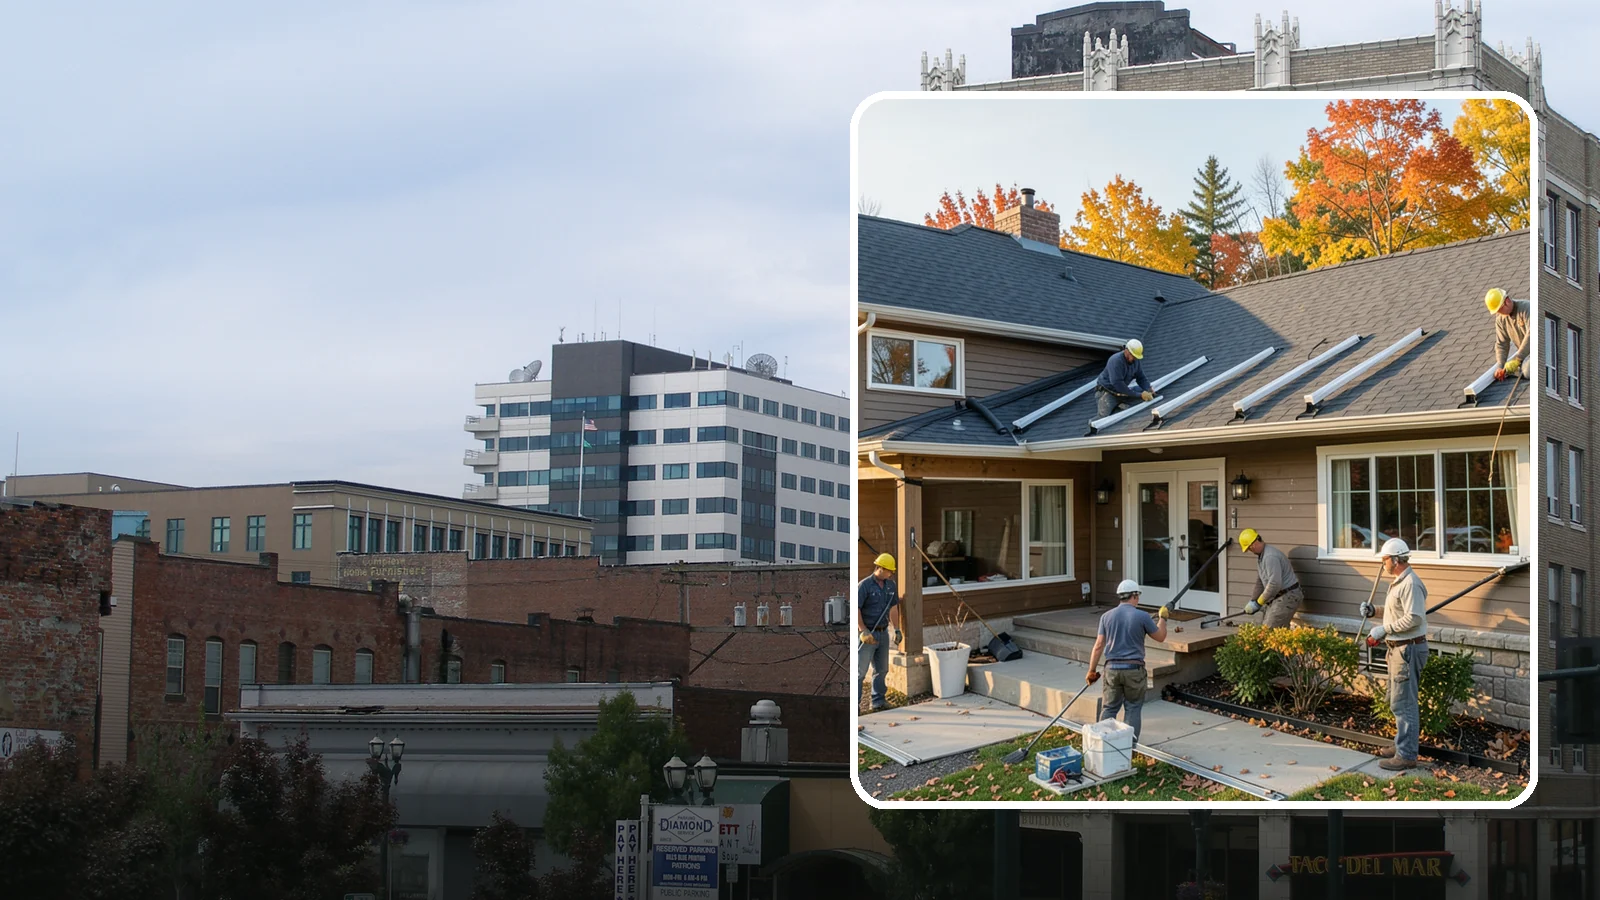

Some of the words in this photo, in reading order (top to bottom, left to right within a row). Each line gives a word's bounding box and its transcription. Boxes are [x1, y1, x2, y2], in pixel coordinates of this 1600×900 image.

[370, 566, 427, 576] Furnishers
[660, 818, 713, 833] DIAMOND
[1021, 815, 1070, 828] BUILDING
[617, 825, 625, 852] PAY
[628, 824, 636, 852] PAY
[656, 845, 688, 853] RESERVED
[689, 846, 716, 854] PARKING
[722, 852, 739, 863] Soup
[671, 862, 701, 870] PATRONS
[1289, 855, 1330, 875] TAC
[1346, 856, 1384, 875] DEL
[1392, 857, 1442, 877] MAR
[616, 856, 625, 893] HERE
[627, 855, 636, 893] HERE
[660, 888, 682, 897] PUBLIC
[683, 889, 710, 898] PARKING
